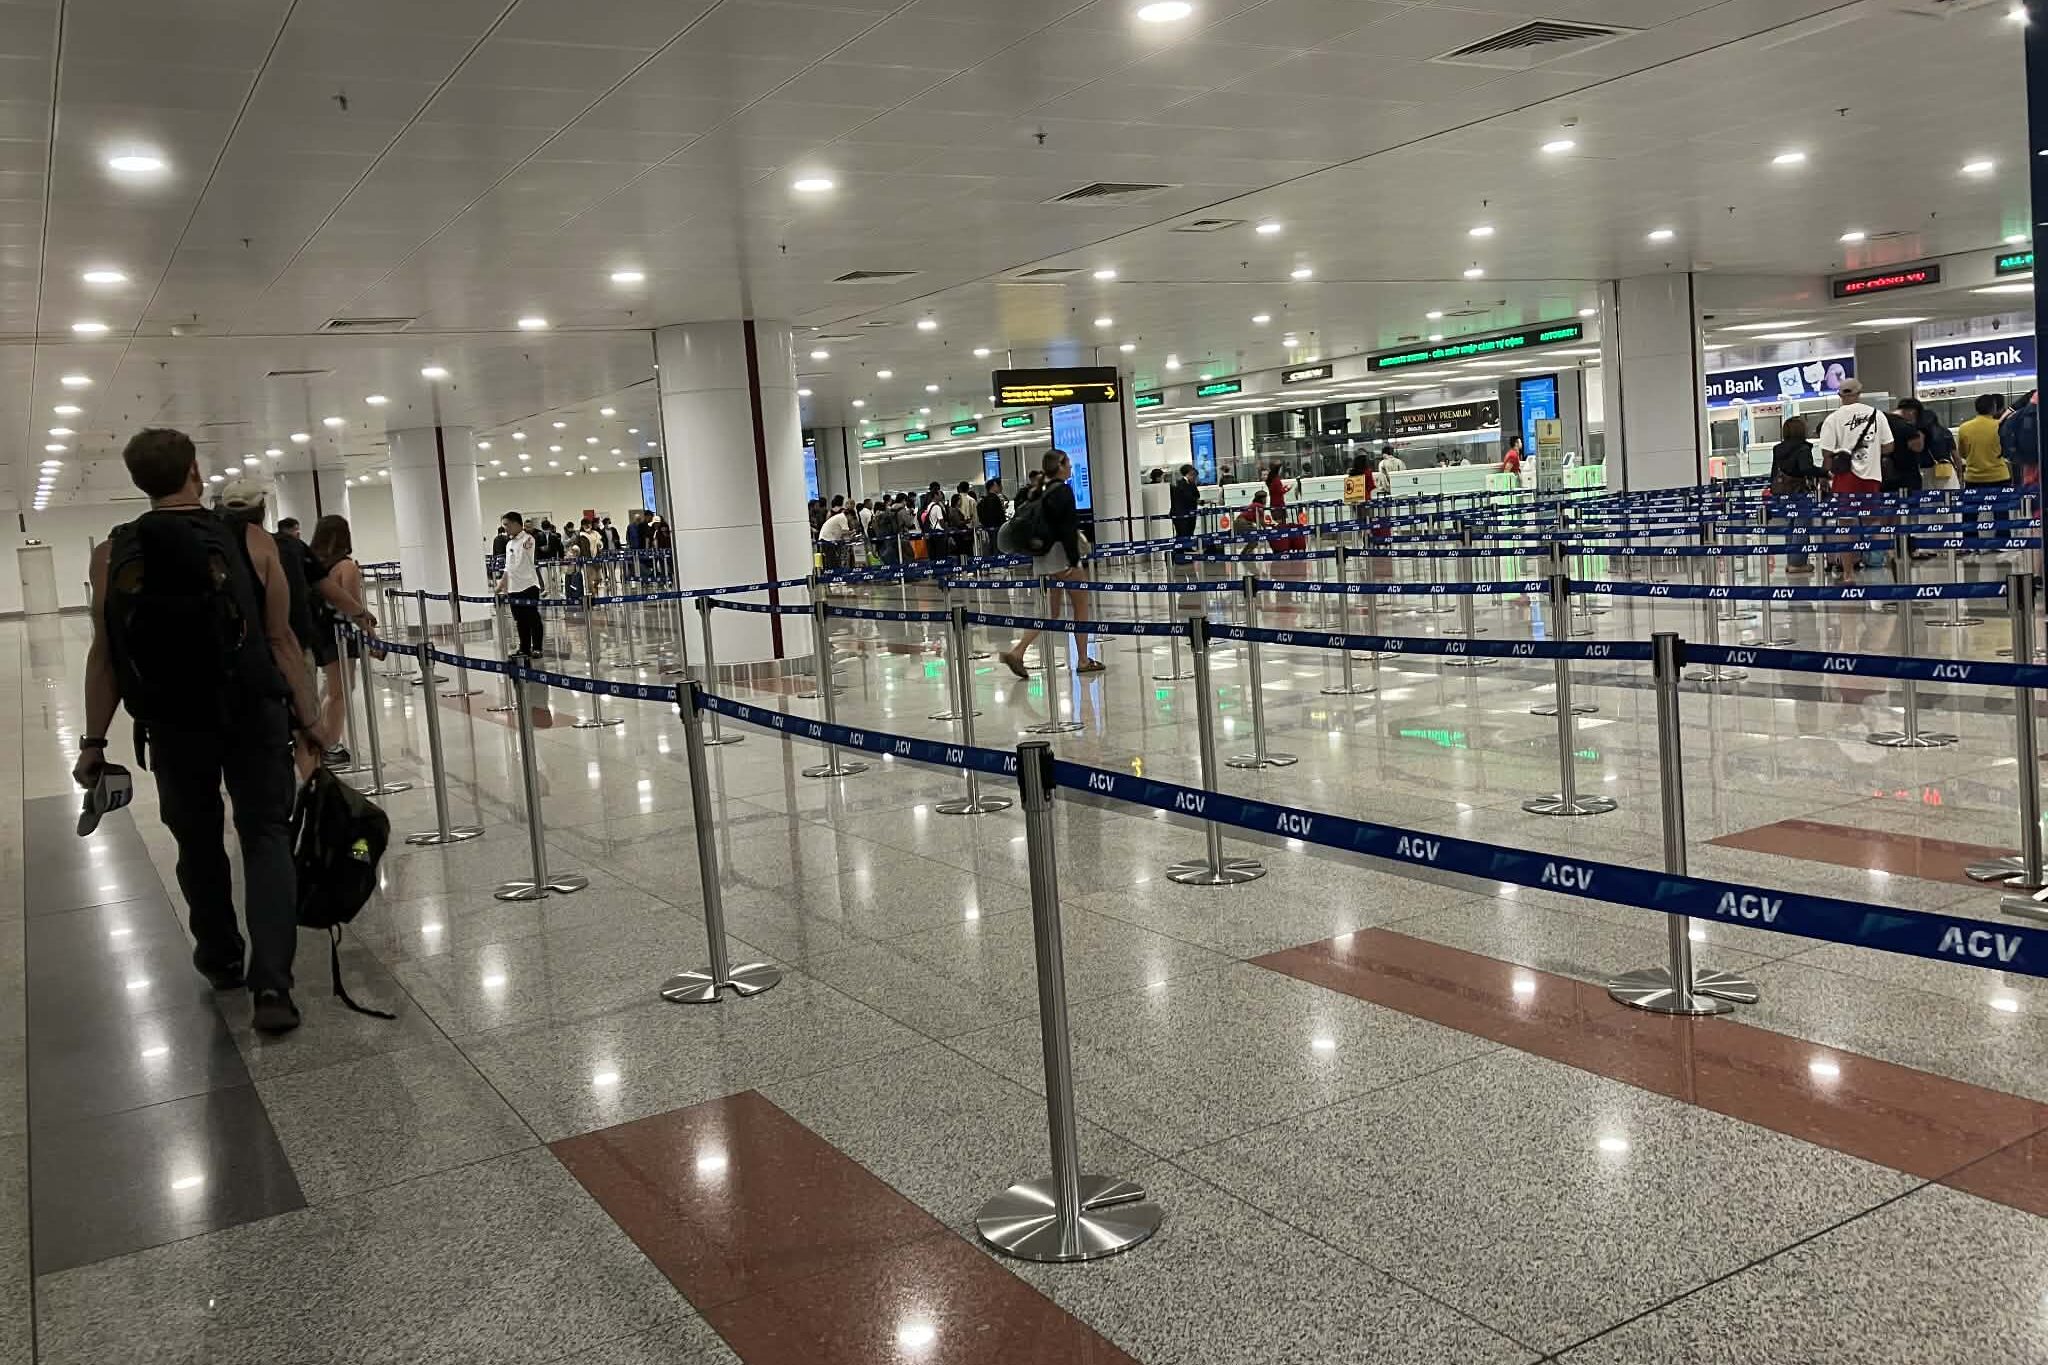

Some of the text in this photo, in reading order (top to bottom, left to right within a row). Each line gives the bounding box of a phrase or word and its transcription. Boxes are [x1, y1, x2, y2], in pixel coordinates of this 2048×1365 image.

[1918, 346, 2022, 373] nhan Bank
[1725, 376, 1764, 395] Bank
[1402, 413, 1426, 423] WOORI
[1440, 408, 1472, 419] PREMIUM
[1663, 547, 1678, 555] ACV
[1753, 546, 1769, 554] ACV
[1595, 584, 1942, 598] ACV ACV ACV ACV ACV ACV
[1098, 624, 1108, 632] ACV
[1230, 629, 1610, 656] ACV ACV ACV ACV ACV ACV ACV
[1727, 651, 1970, 678] ACV ACV ACV
[809, 724, 821, 736] ACV
[850, 732, 863, 745] ACV
[895, 740, 910, 754] ACV
[946, 748, 963, 763] ACV
[1089, 773, 2021, 961] ACV ACV ACV ACV ACV ACV ACV
